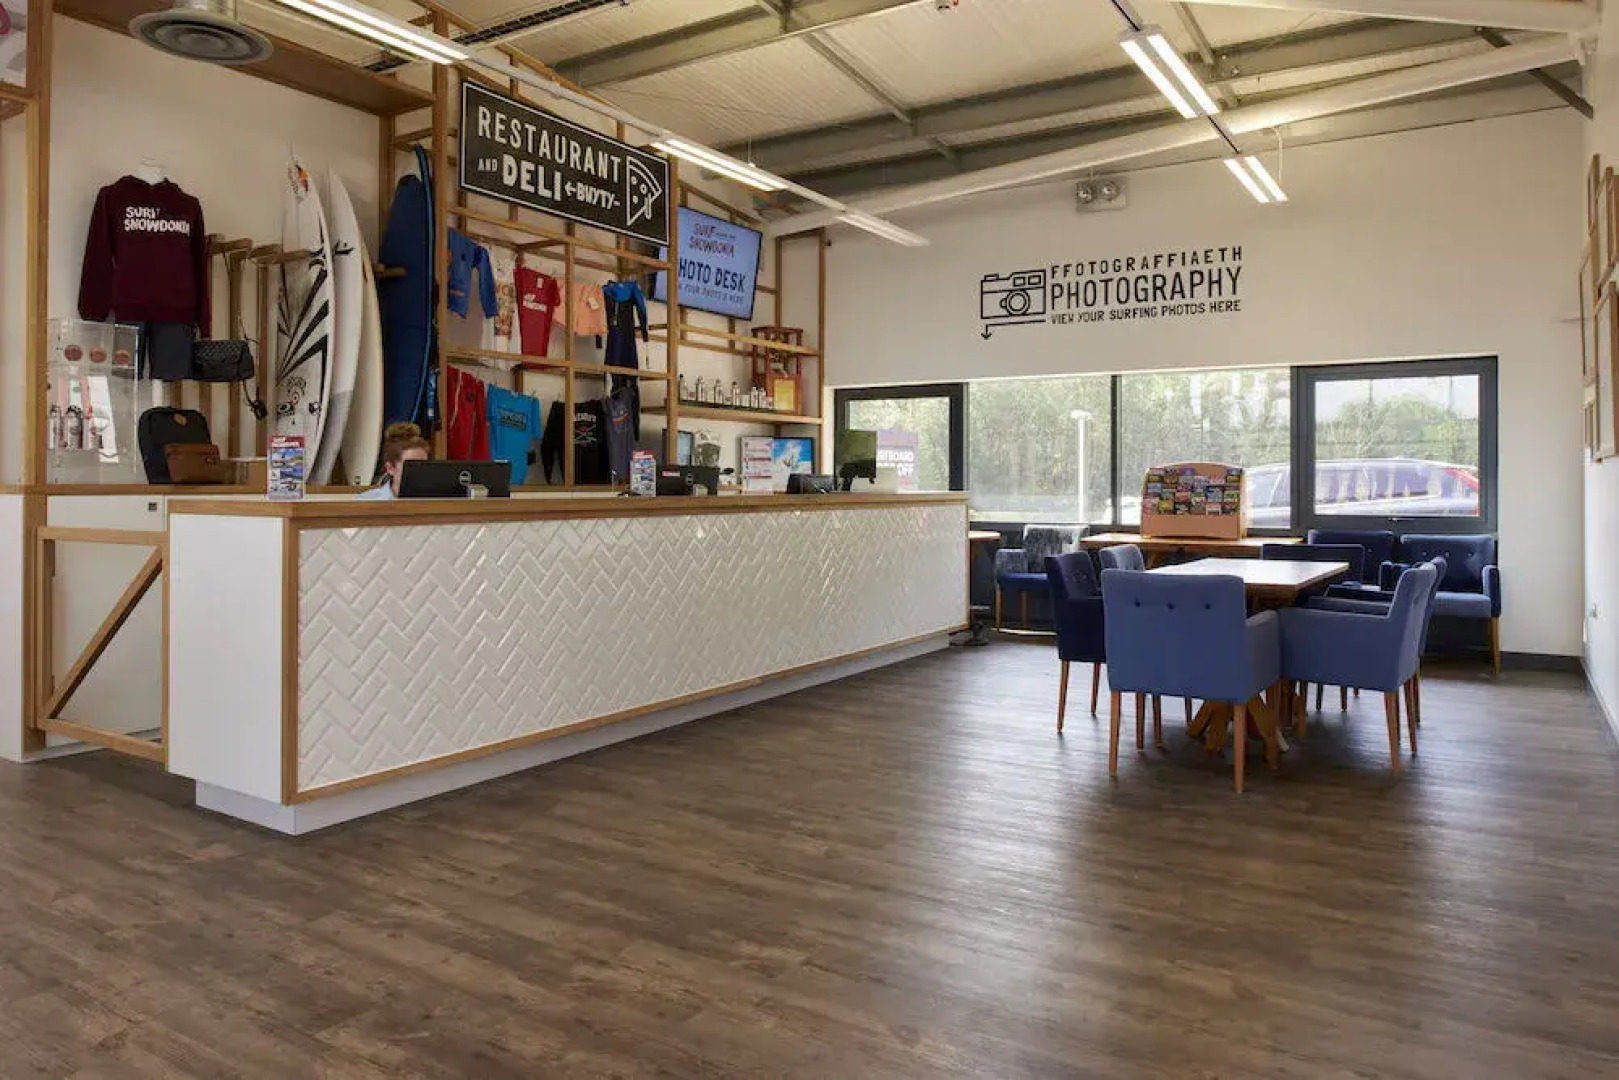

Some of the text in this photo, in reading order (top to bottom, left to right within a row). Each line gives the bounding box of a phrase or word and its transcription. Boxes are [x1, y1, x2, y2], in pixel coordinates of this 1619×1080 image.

[478, 106, 621, 183] RESTAURANT
[478, 158, 498, 172] AND
[502, 153, 562, 201] DELI
[678, 257, 746, 292] HOTO DESK
[1051, 245, 1242, 279] FFOTOGRAFFIAETH
[1051, 265, 1242, 310] PHOTOGRAPHY
[1051, 299, 1241, 324] VIEW YOUR SURFING PHOTOS HERE
